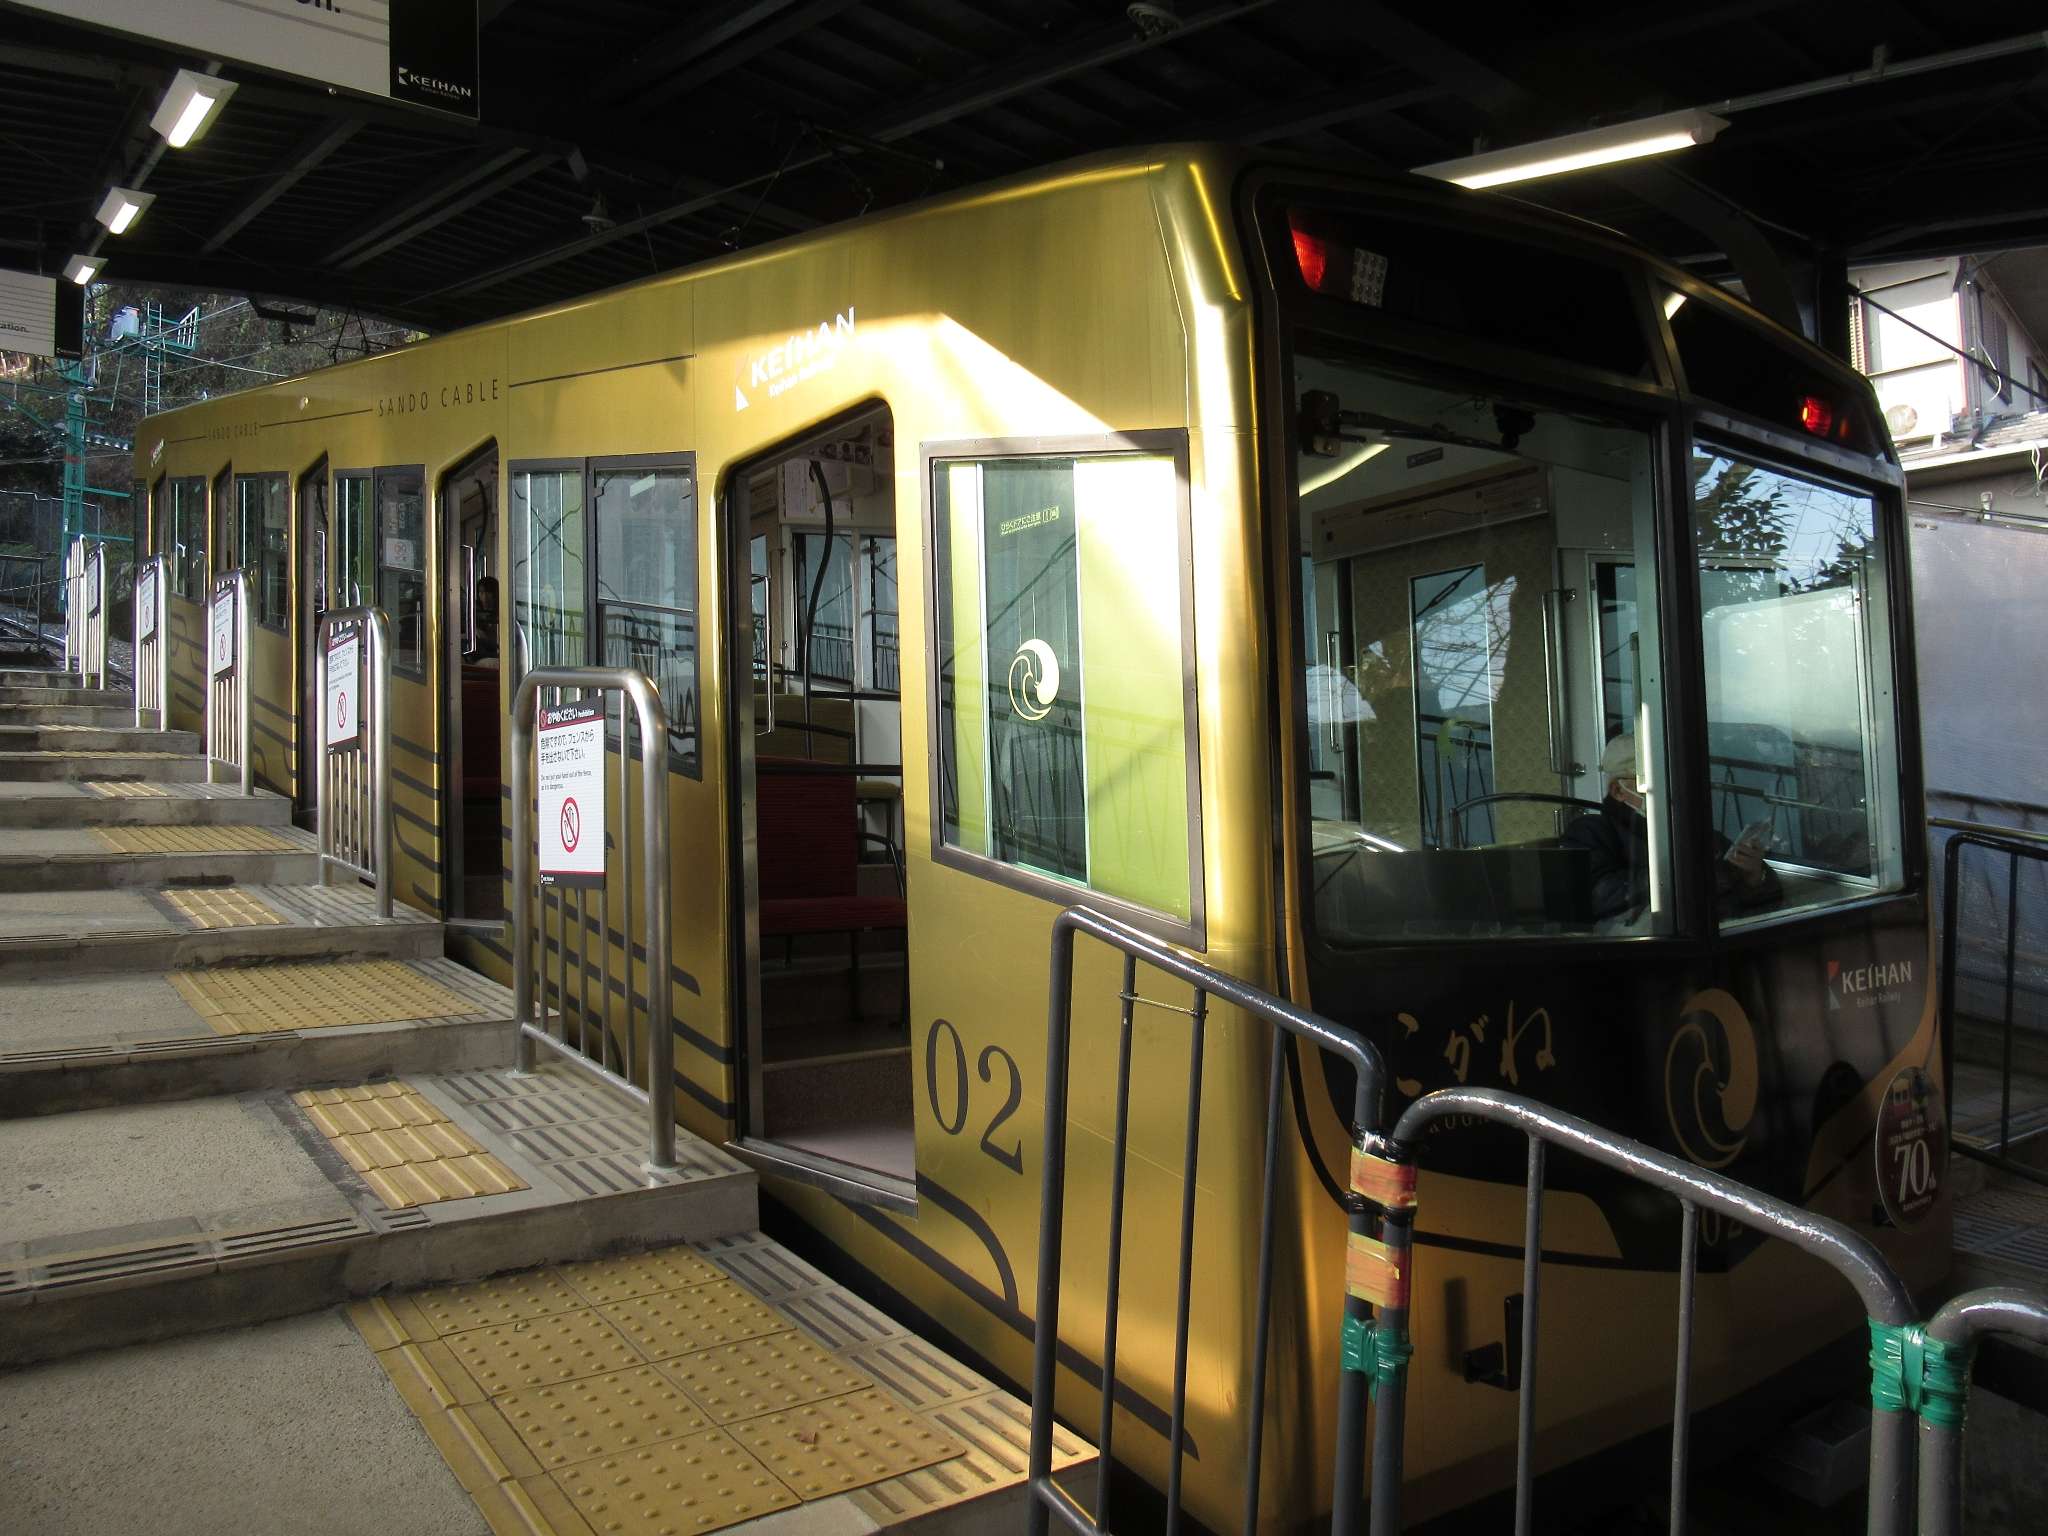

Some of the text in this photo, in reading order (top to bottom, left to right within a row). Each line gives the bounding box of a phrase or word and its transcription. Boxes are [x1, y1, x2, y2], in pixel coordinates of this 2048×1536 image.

[410, 73, 472, 98] KEIHAN
[751, 306, 855, 389] KEIHAN
[379, 379, 498, 417] SANDO CABLE
[1842, 960, 1912, 994] KEIHAN
[1396, 1000, 1556, 1097] こがね
[925, 1018, 1024, 1176] 02
